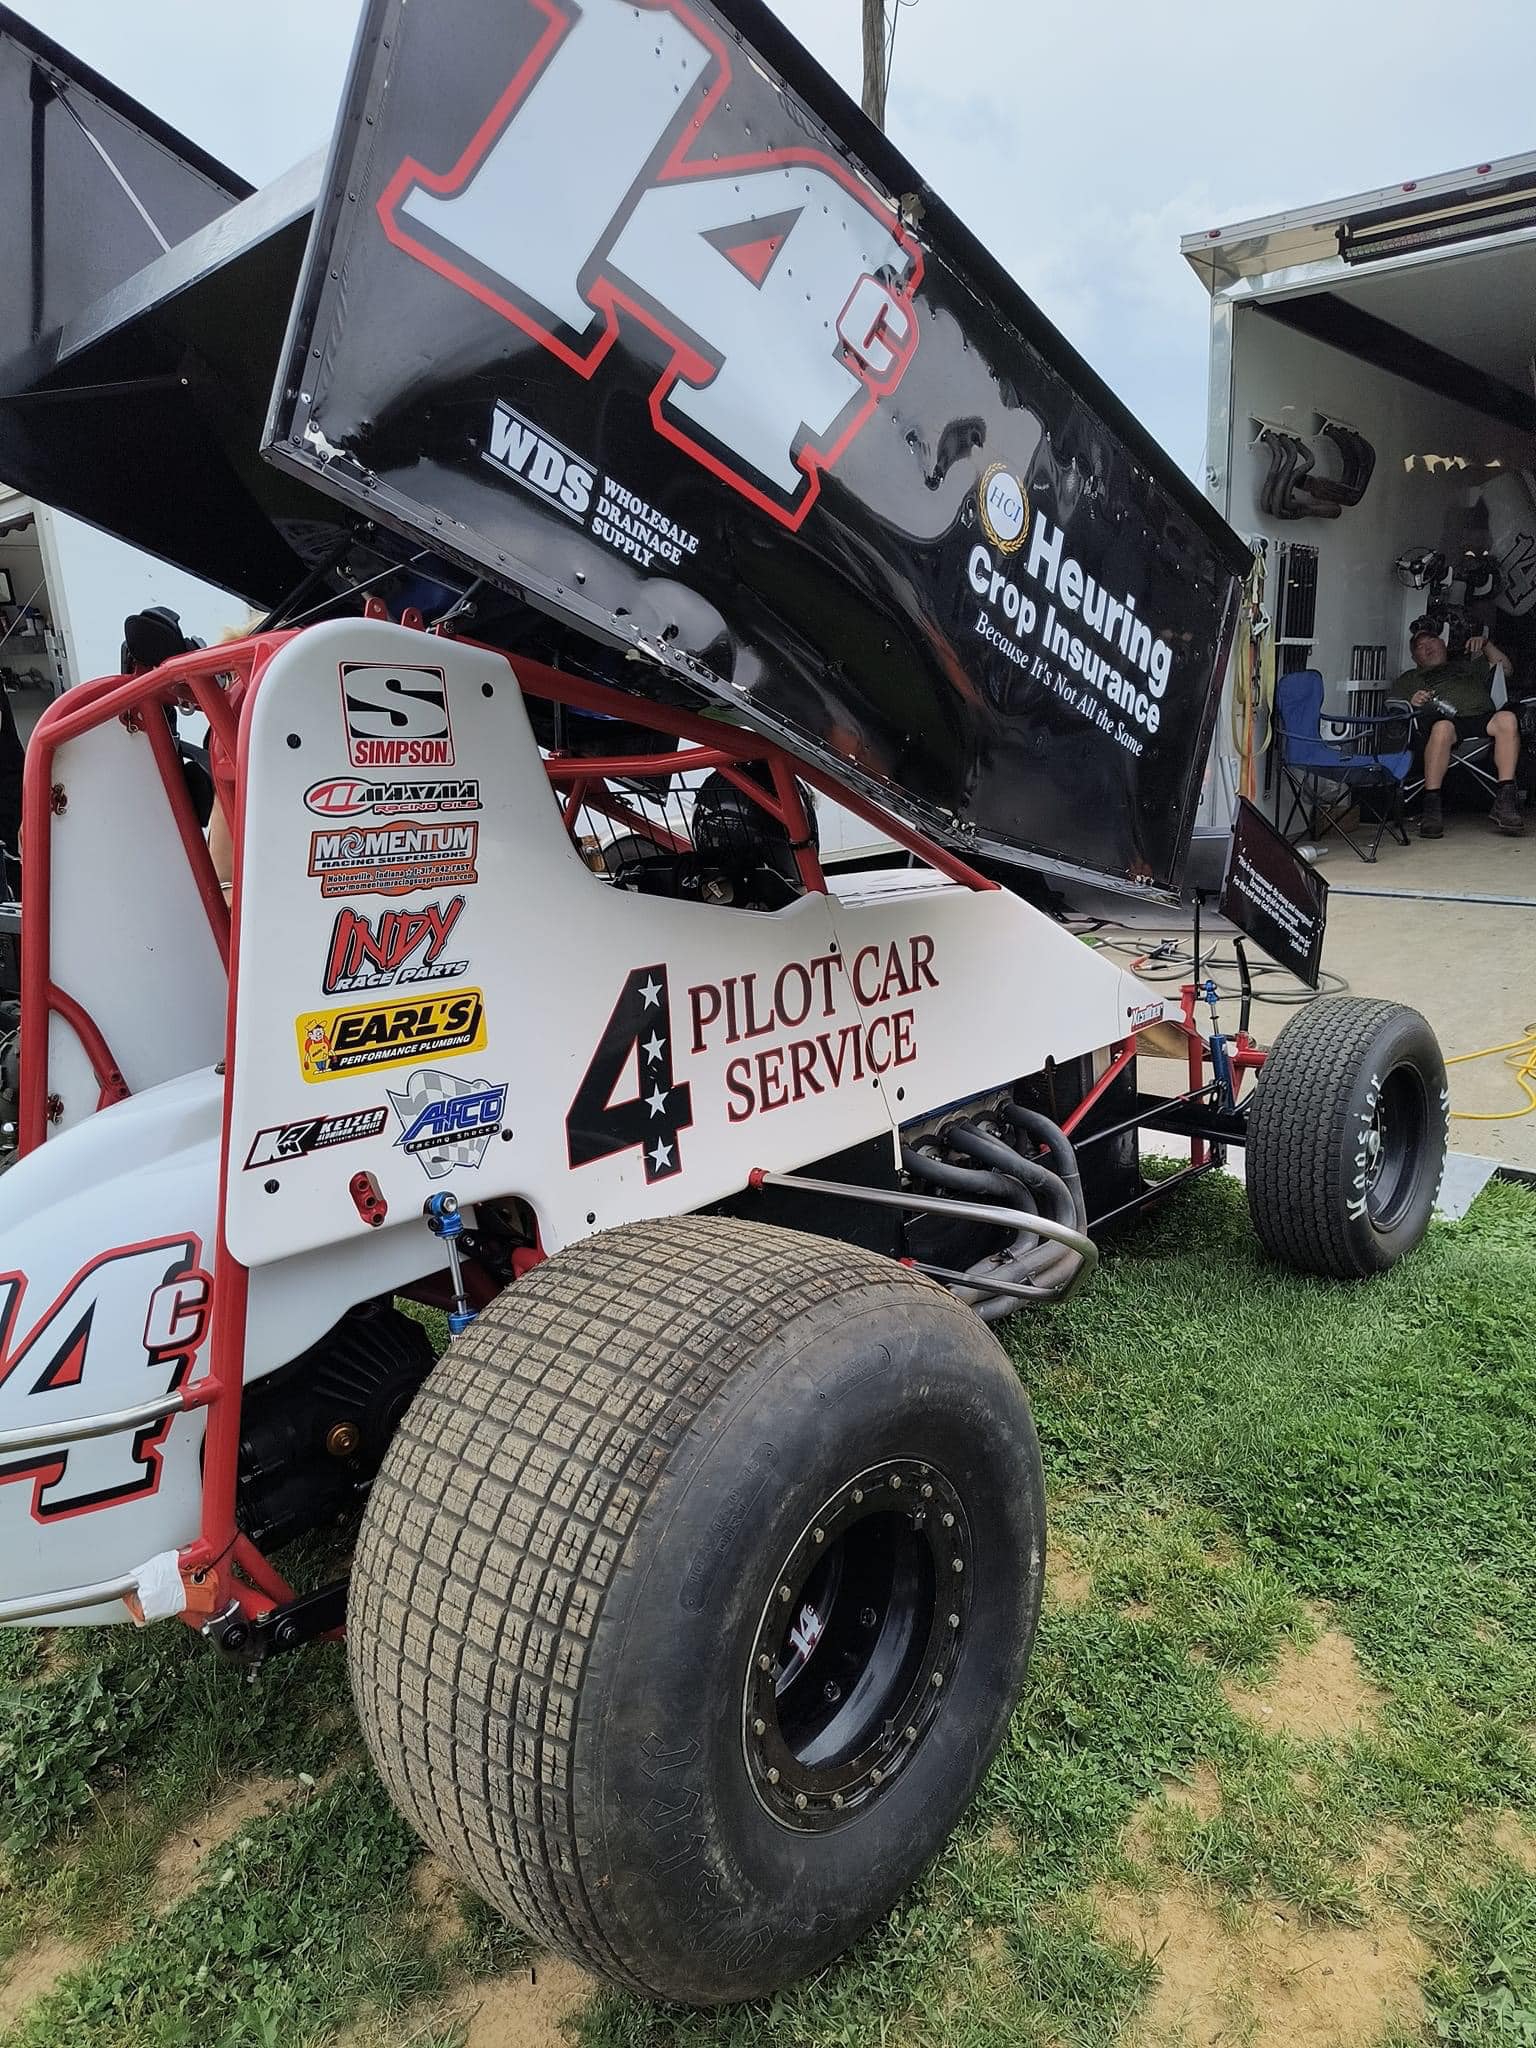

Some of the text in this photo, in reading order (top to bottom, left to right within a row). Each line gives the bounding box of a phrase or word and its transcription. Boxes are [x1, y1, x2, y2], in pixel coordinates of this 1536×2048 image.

[490, 408, 594, 512] WDS
[596, 496, 682, 565] DRAINAGE
[604, 476, 699, 555] WHOLESALE
[989, 486, 1023, 524] HCI
[591, 516, 655, 567] SUPPLY
[1027, 509, 1173, 698] Heuring
[968, 545, 1161, 733] Crop Insurance
[975, 611, 1144, 757] Because It's Not All the Same
[355, 740, 449, 764] SIMPSON
[357, 782, 476, 802] MAXIMA
[374, 800, 478, 813] RACING OILS
[316, 826, 474, 859] MOMENTUM
[321, 850, 467, 869] RACING SUSPENSIONS
[376, 868, 404, 880] Indiana
[327, 897, 465, 990] INDY
[335, 961, 469, 991] RACE PARTS
[687, 934, 940, 1054] PILOT CAR
[335, 998, 473, 1049] EARL'S
[339, 1034, 471, 1067] PERFORMANCE PLUMBING
[565, 963, 694, 1185] 4
[724, 1008, 917, 1123] SERVICE
[319, 1110, 385, 1134] KEIZER
[400, 1087, 504, 1142] AFCO
